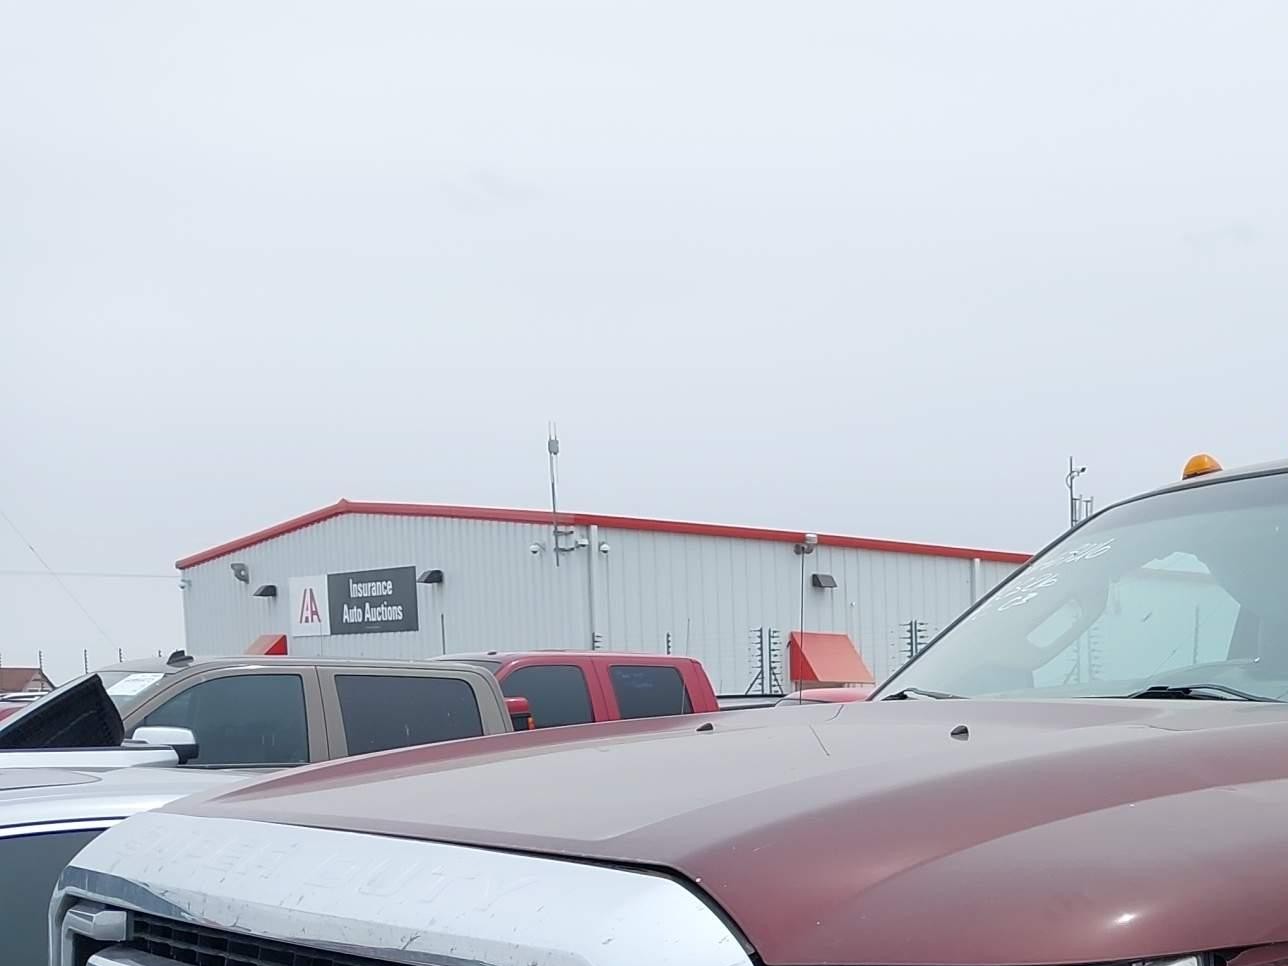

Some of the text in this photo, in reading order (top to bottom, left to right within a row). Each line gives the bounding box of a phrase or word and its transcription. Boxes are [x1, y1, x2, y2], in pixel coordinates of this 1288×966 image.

[349, 578, 393, 599] Insurance
[342, 600, 403, 624] Auto Auctions
